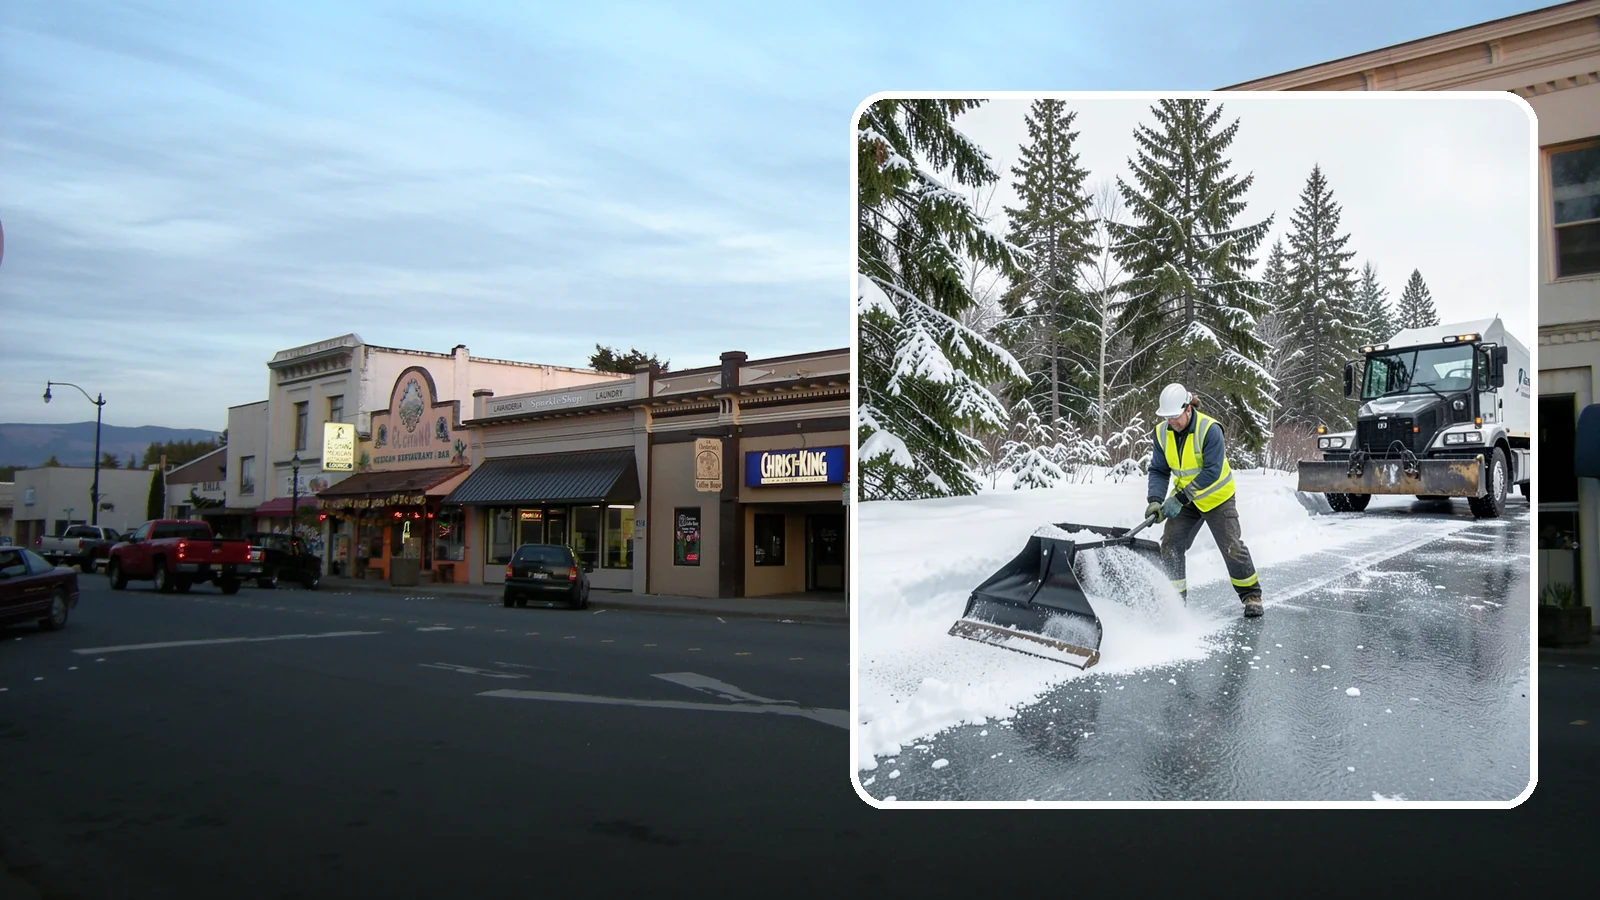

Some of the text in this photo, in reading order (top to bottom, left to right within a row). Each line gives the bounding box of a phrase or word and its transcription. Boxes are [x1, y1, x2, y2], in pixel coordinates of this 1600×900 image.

[530, 394, 582, 409] Sparkle Shop
[595, 389, 623, 400] LAUNDRY
[493, 402, 522, 412] LAVANDERIA
[373, 455, 396, 464] MEXICAN
[397, 451, 433, 462] RESTAURANT
[437, 450, 450, 459] BAR
[761, 450, 827, 478] CHRIST KING
